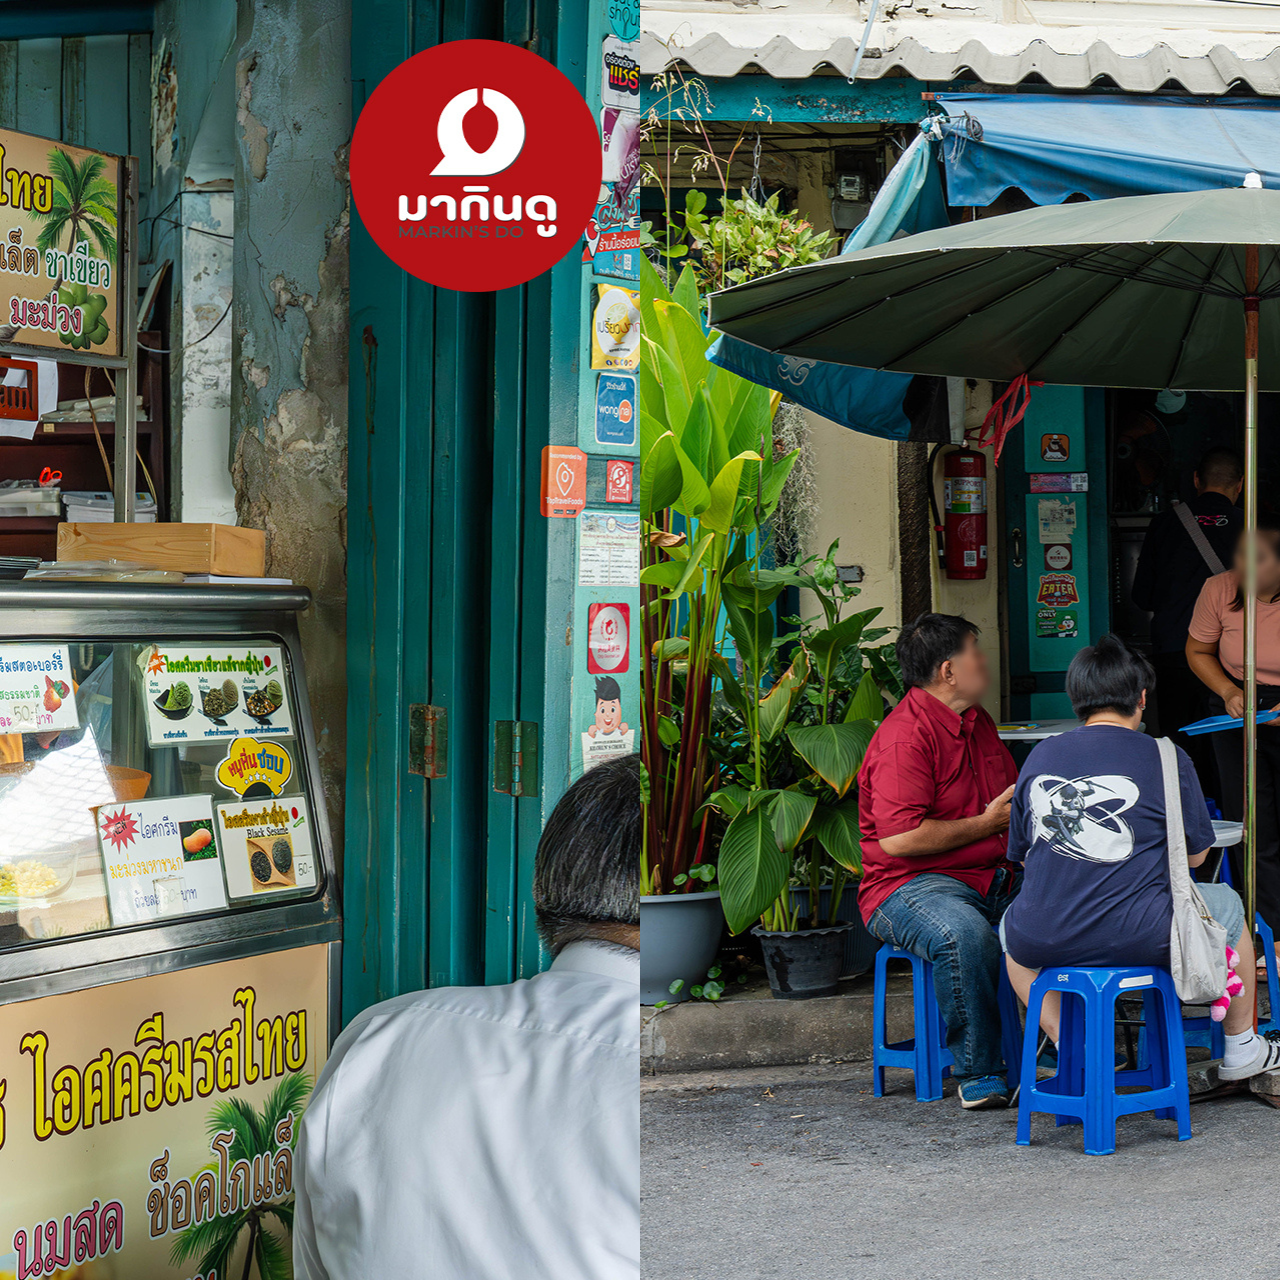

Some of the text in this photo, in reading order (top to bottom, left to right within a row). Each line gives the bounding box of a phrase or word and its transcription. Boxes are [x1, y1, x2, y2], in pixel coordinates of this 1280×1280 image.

[609, 65, 640, 89] แชร์
[45, 242, 111, 288] ชาเขียว
[10, 296, 82, 334] มะม่วง
[599, 404, 632, 421] wongnai
[1042, 583, 1075, 596] EATER
[137, 812, 178, 839] ไอศกรีม
[247, 826, 288, 838] Black Sesame
[109, 853, 183, 879] มะม่วงมหาชนก
[181, 887, 197, 902] บาท
[20, 986, 307, 1141] ไอศครีมรสไทย
[15, 1200, 124, 1279] นมสด
